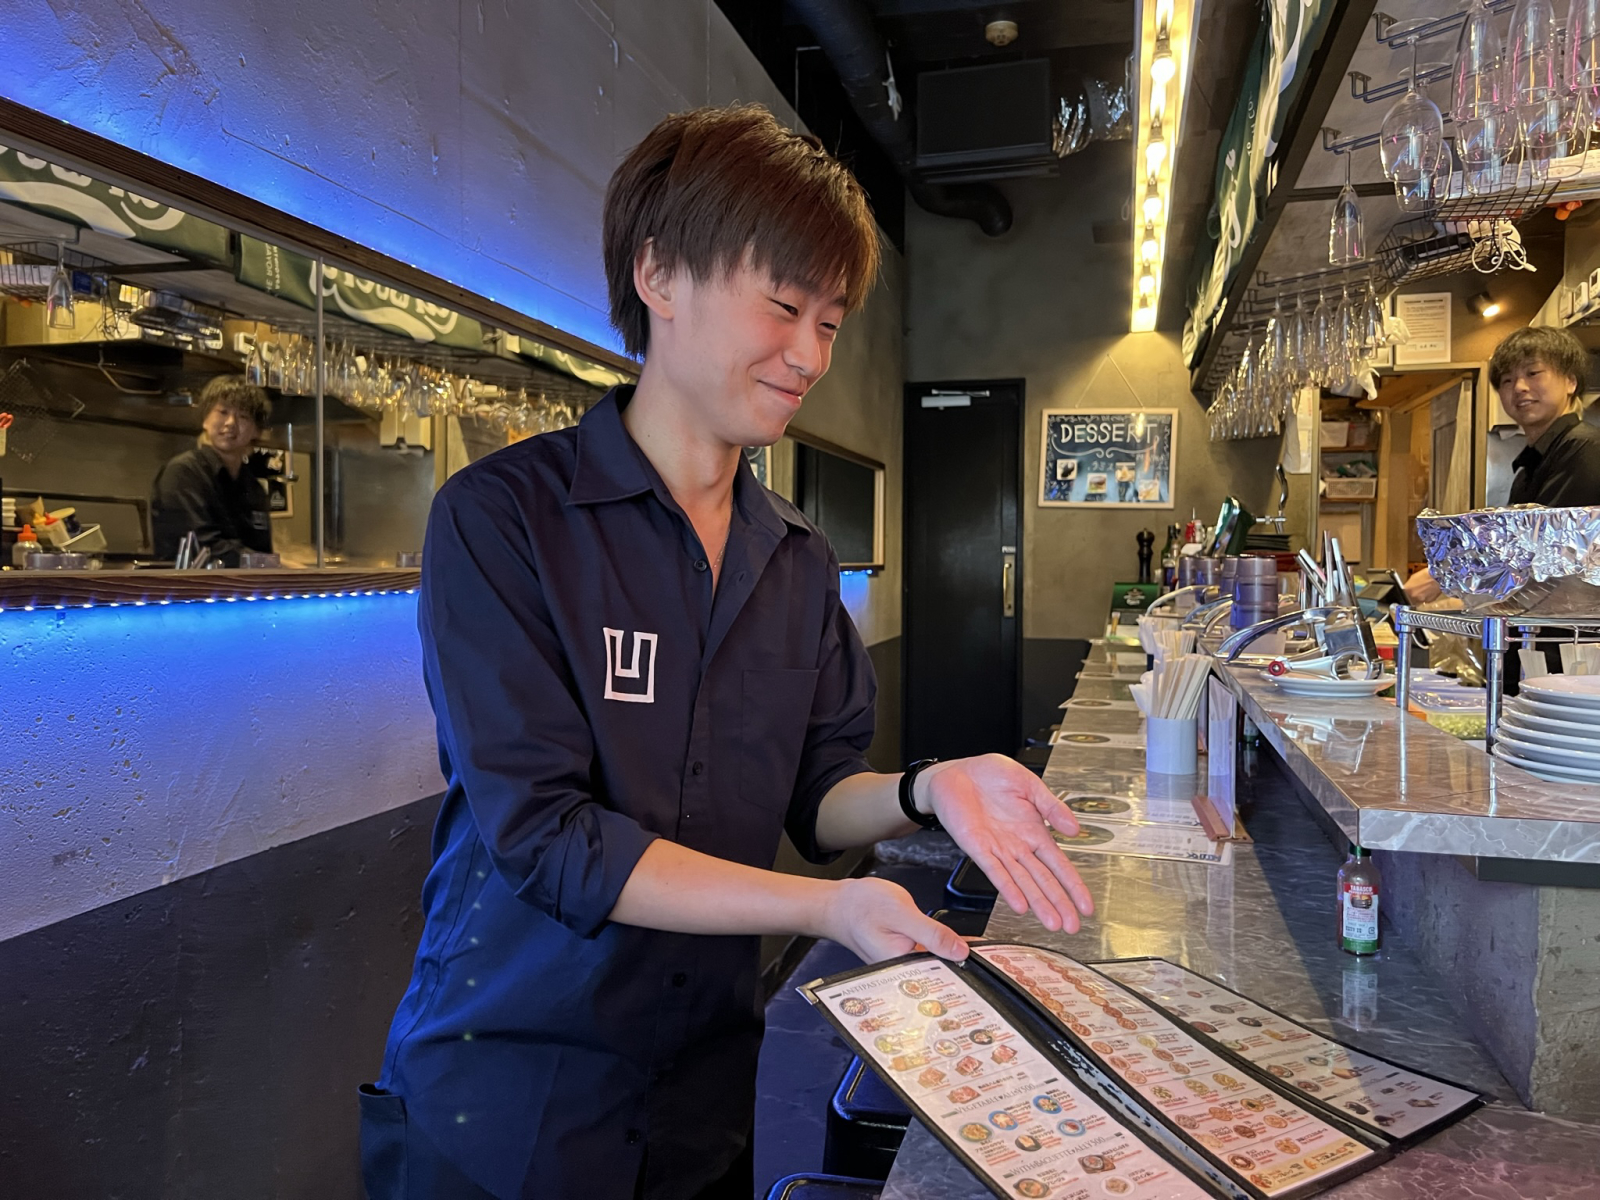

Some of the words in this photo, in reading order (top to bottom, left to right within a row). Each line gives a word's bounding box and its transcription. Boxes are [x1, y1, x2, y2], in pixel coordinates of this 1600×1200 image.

[1060, 423, 1158, 444] DESSERT
[954, 1096, 998, 1114] VEGETABLE
[1035, 1150, 1072, 1168] BAGUETTE
